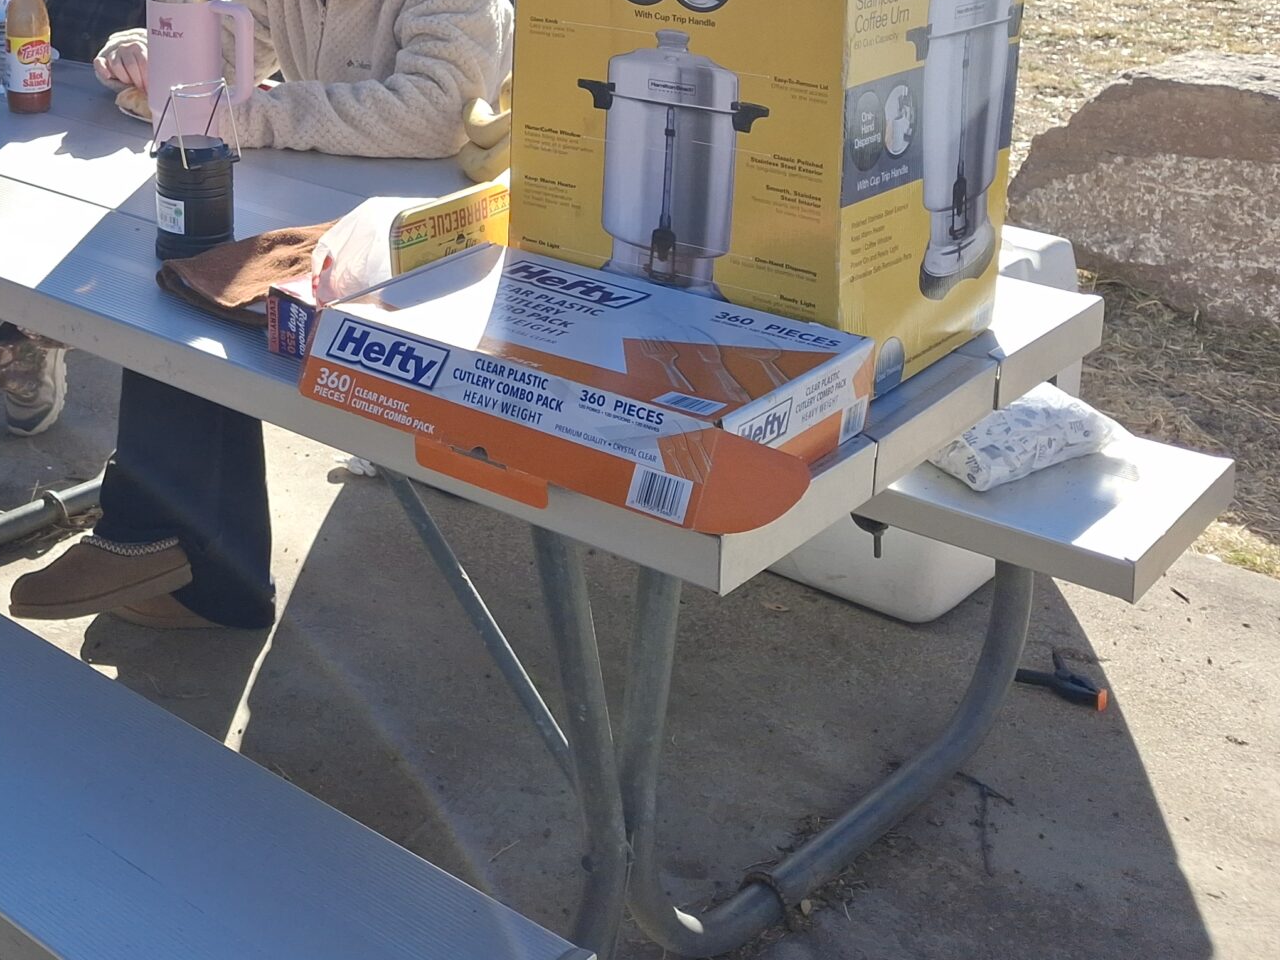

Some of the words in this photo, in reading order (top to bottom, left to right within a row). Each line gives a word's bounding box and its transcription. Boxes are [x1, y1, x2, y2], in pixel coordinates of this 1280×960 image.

[635, 9, 653, 19] With
[654, 13, 671, 24] Cup
[671, 15, 687, 25] Trip
[688, 17, 716, 28] Handle
[855, 10, 887, 34] Coffee
[151, 29, 184, 38] STANLEY
[23, 79, 46, 87] Sauce
[29, 72, 43, 80] Hot
[854, 134, 881, 149] Dispensing
[750, 157, 779, 168] Stainless
[857, 179, 869, 191] With
[870, 176, 880, 187] Cup
[881, 172, 890, 183] Trip
[891, 165, 909, 180] Handle
[429, 197, 488, 239] BARBECUE
[509, 264, 632, 304] Hefty
[503, 284, 535, 297] EAR
[535, 293, 605, 317] PLASTIC
[504, 295, 567, 315] UTLERY
[288, 303, 299, 332] Wrap
[526, 313, 575, 328] PACK
[715, 311, 754, 326] 360
[764, 324, 842, 348] PIECES
[286, 331, 296, 354] 250
[337, 325, 437, 384] Hefty
[316, 368, 351, 392] 360
[475, 358, 504, 377] CLEAR
[507, 366, 549, 390] PLASTIC
[806, 382, 821, 396] CLEAR
[821, 370, 840, 386] PLASTIC
[313, 385, 346, 403] PIECES
[354, 387, 377, 402] CLEAR
[379, 394, 410, 413] PLASTIC
[453, 368, 495, 390] CUTLERY
[497, 381, 534, 403] COMBO
[536, 394, 564, 413] PACK
[795, 395, 816, 414] CUTLERY
[816, 385, 834, 401] COMBO
[835, 378, 847, 391] PACK
[351, 399, 382, 418] CUTLERY
[384, 408, 412, 426] COMBO
[414, 419, 435, 434] PACK
[463, 389, 499, 410] HEAVY
[501, 401, 543, 425] WEIGHT
[580, 390, 606, 407] 360
[614, 400, 664, 425] PIECES
[741, 409, 787, 443] Hefty
[555, 424, 583, 439] PREMIUM
[583, 432, 607, 447] QUALITY
[613, 441, 637, 458] CRYSTAL
[637, 448, 657, 463] CLEAR
